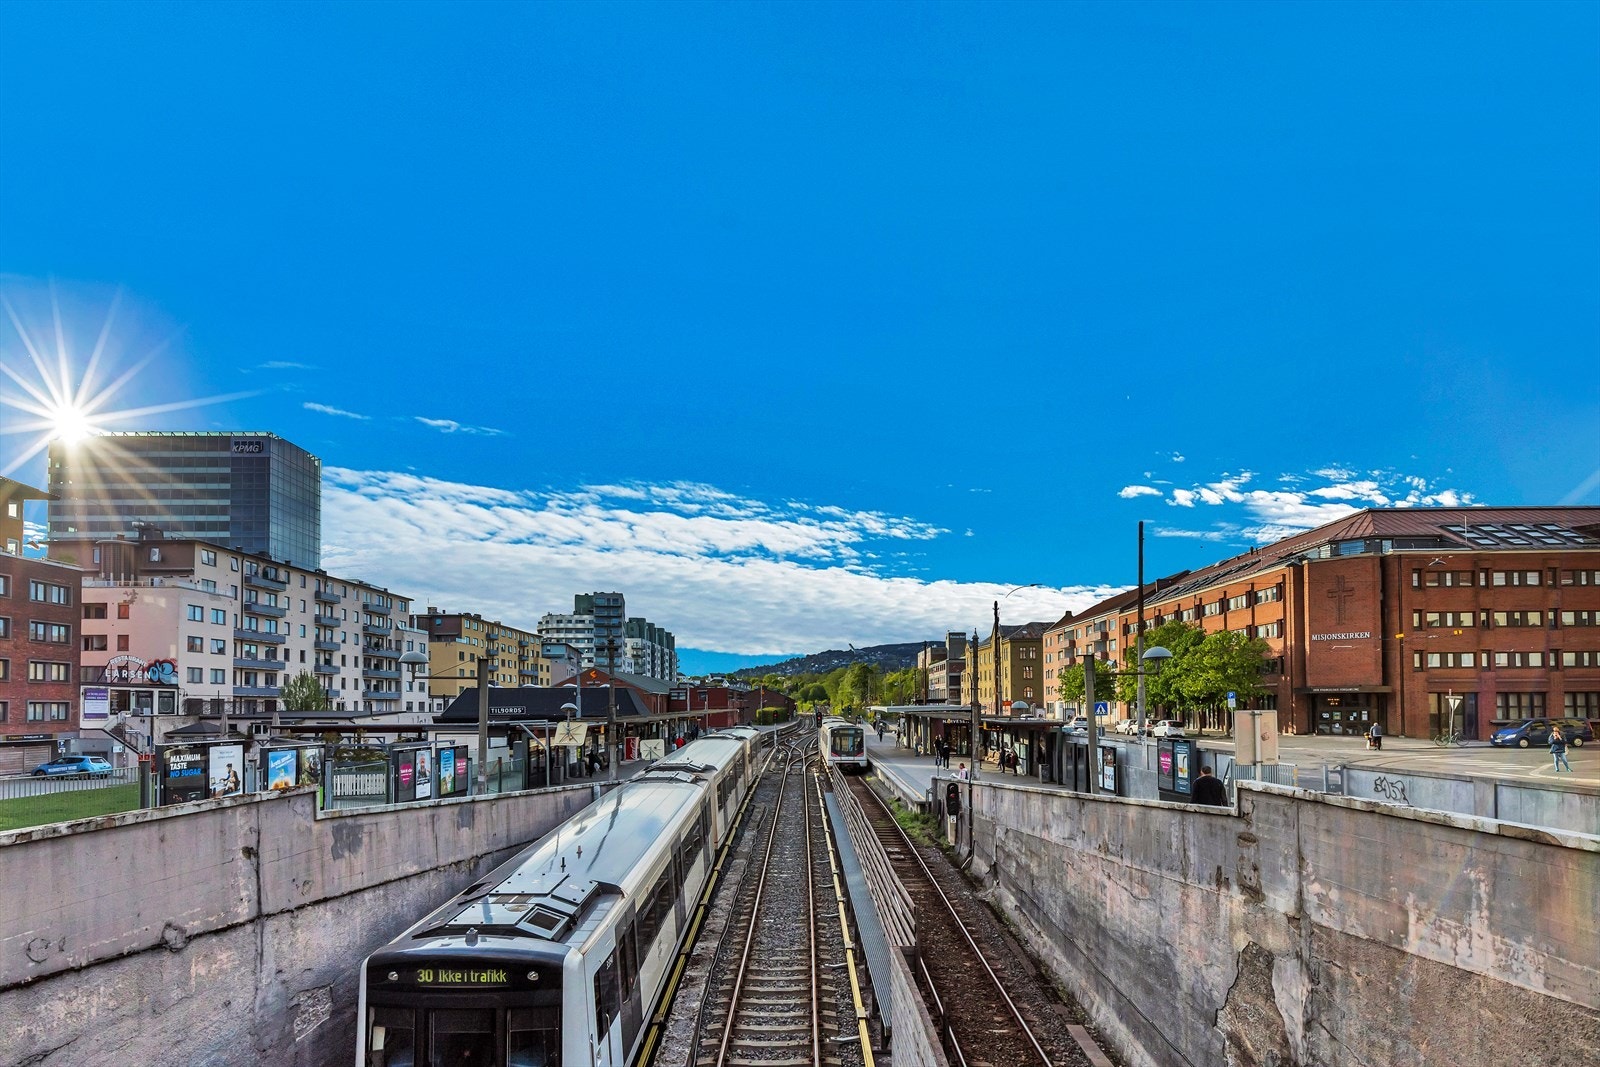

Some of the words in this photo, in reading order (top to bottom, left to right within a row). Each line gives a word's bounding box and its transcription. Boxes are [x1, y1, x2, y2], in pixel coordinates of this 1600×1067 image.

[231, 444, 261, 453] KPMG
[1311, 631, 1370, 641] MISJONSKIRKEN
[110, 655, 147, 667] RESTAURANT
[105, 668, 151, 679] LARSEN
[169, 753, 201, 763] MAXIMUM
[169, 762, 188, 771] TASTE
[181, 768, 202, 777] SUGAR
[416, 969, 434, 983] 30
[438, 969, 462, 983] Ikke
[470, 969, 507, 983] trafikk
